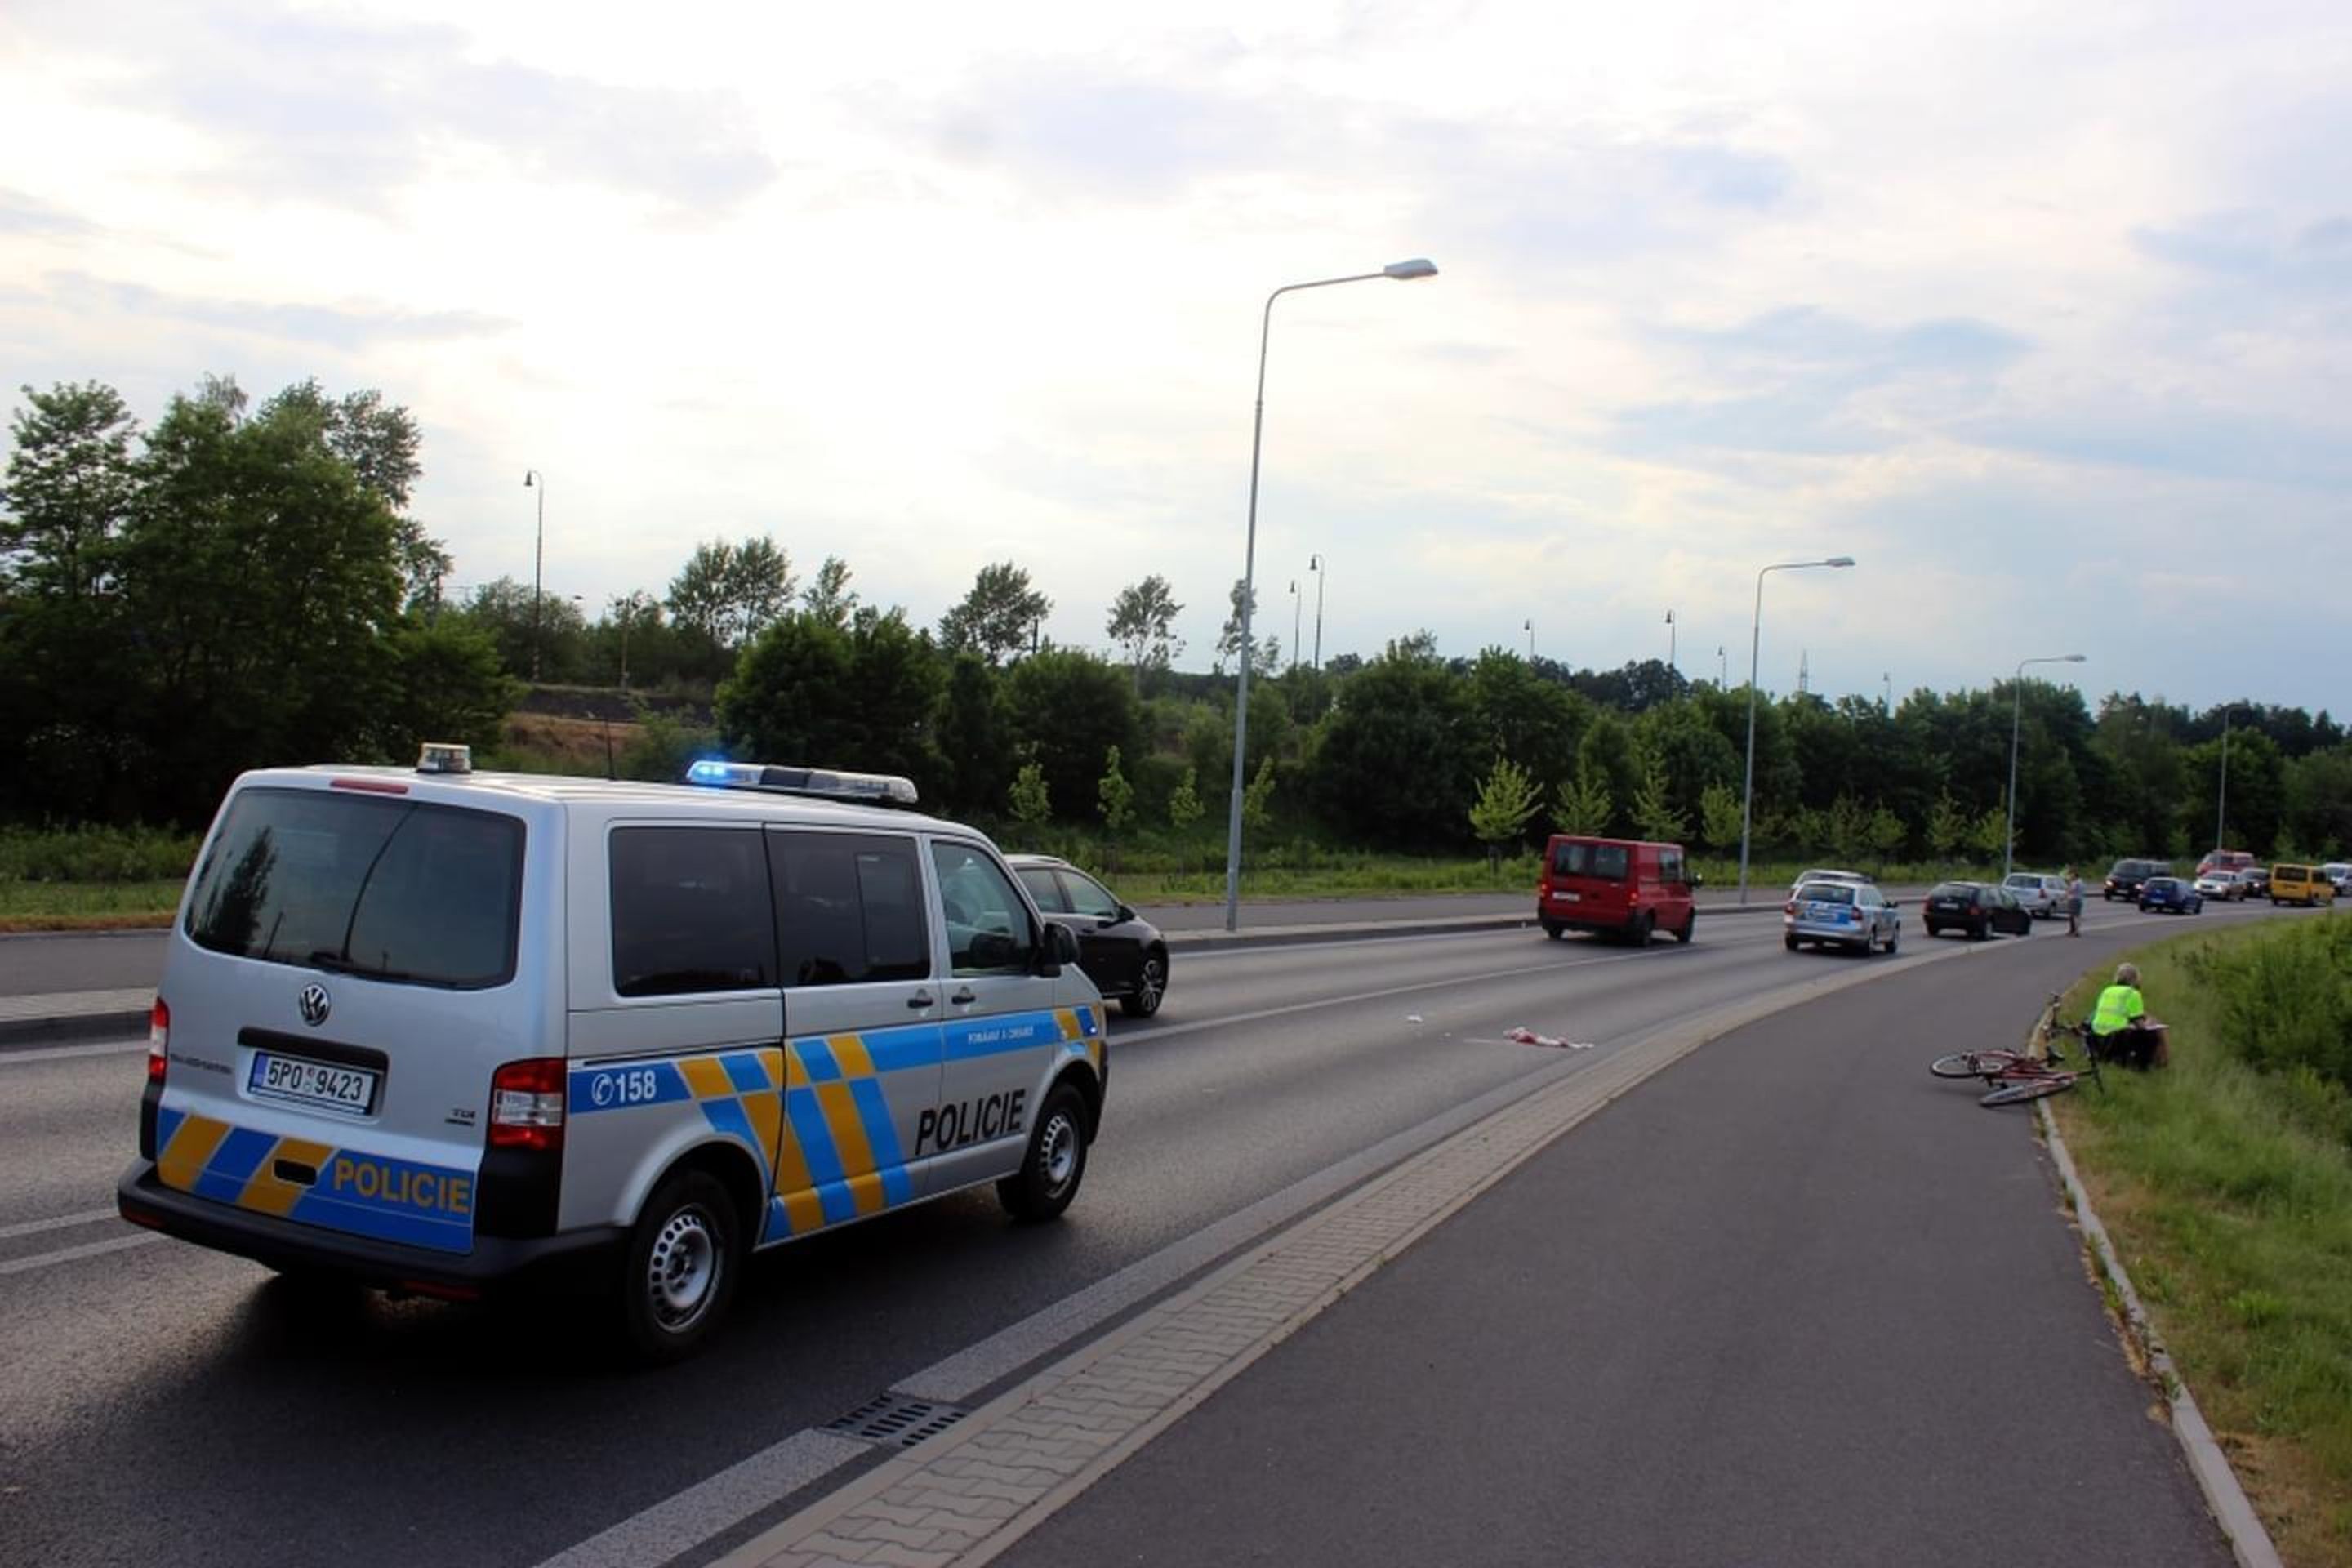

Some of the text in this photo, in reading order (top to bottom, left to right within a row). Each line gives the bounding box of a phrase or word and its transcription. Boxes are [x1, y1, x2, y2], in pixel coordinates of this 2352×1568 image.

[314, 1070, 363, 1101] 9423
[615, 1069, 657, 1103] 158
[915, 1088, 1026, 1156] POLICIE
[334, 1158, 471, 1214] POLICIE
